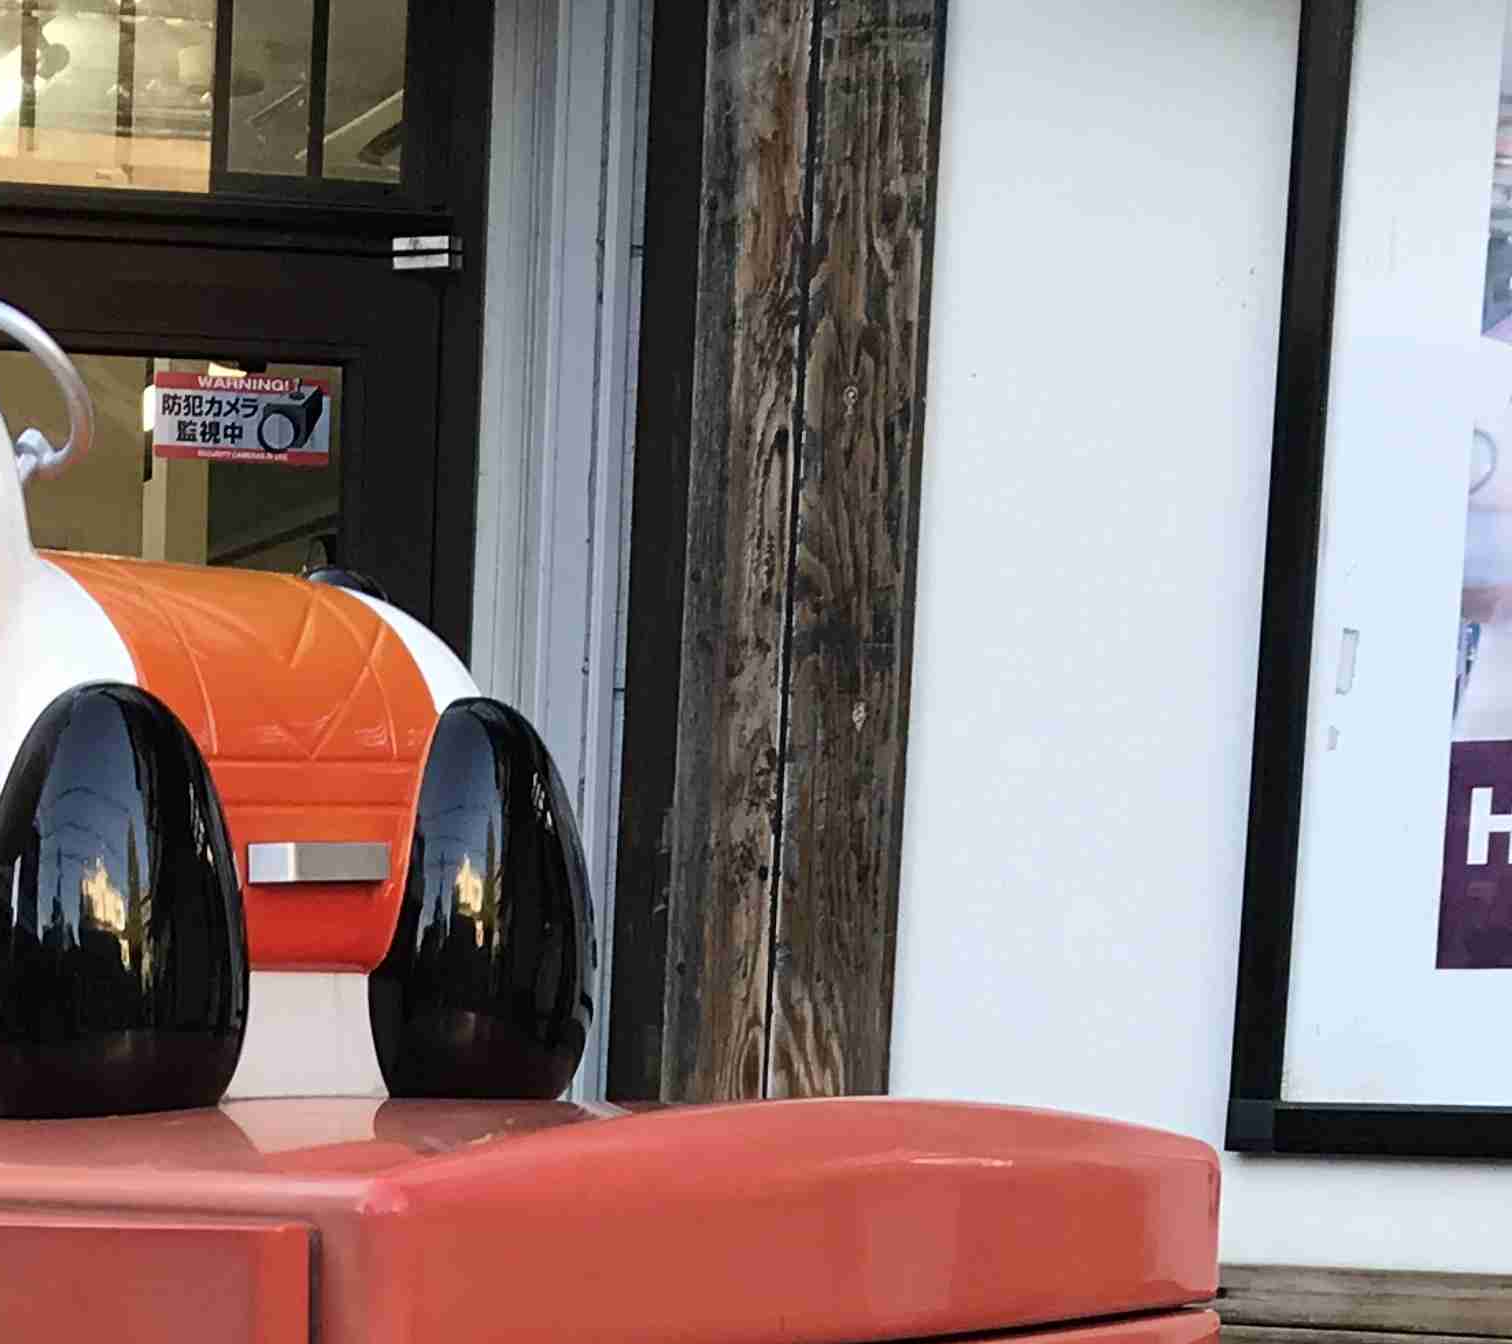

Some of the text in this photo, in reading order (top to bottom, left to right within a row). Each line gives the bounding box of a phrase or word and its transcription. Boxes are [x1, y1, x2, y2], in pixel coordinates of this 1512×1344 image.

[161, 393, 259, 418] 防犯カメラ
[176, 420, 243, 444] 監視中
